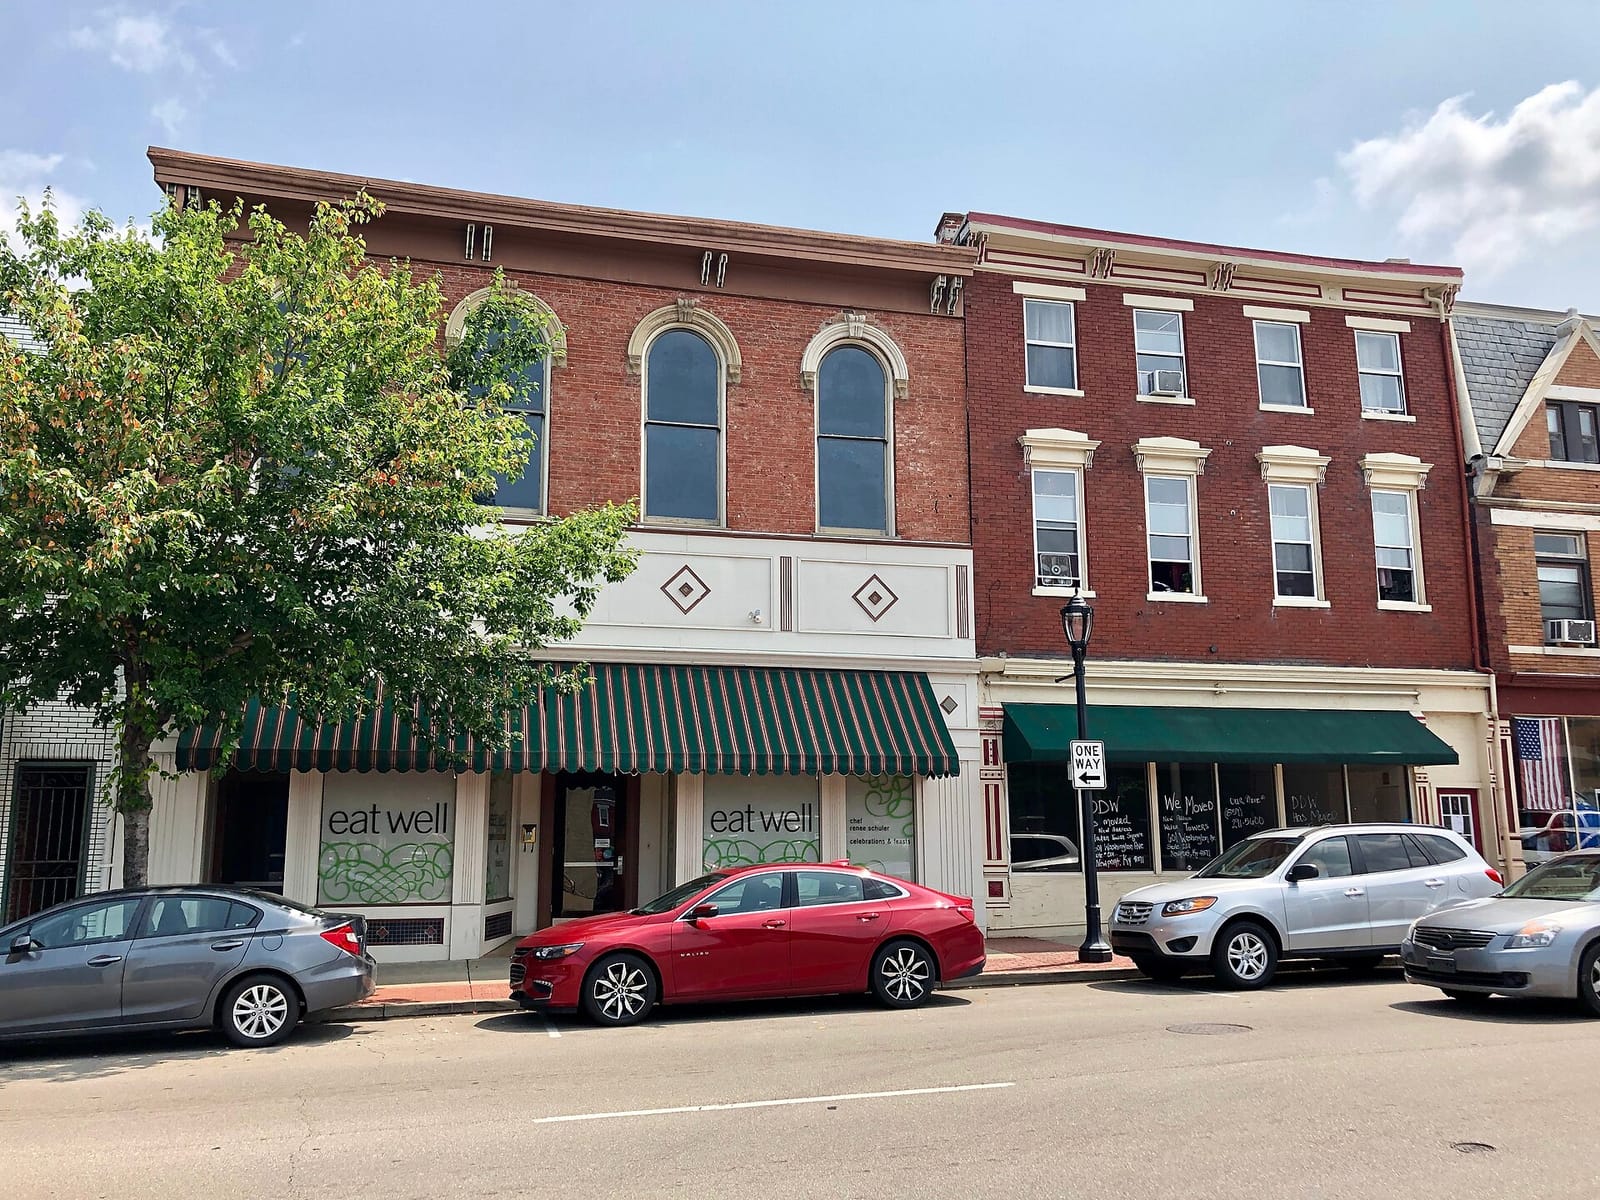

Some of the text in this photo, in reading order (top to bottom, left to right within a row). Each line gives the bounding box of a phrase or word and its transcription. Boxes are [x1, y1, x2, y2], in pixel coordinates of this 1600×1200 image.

[1075, 745, 1100, 757] ONE
[1075, 758, 1101, 770] WAY
[1164, 792, 1182, 811] We
[328, 802, 448, 835] eat well
[710, 803, 812, 833] eat well
